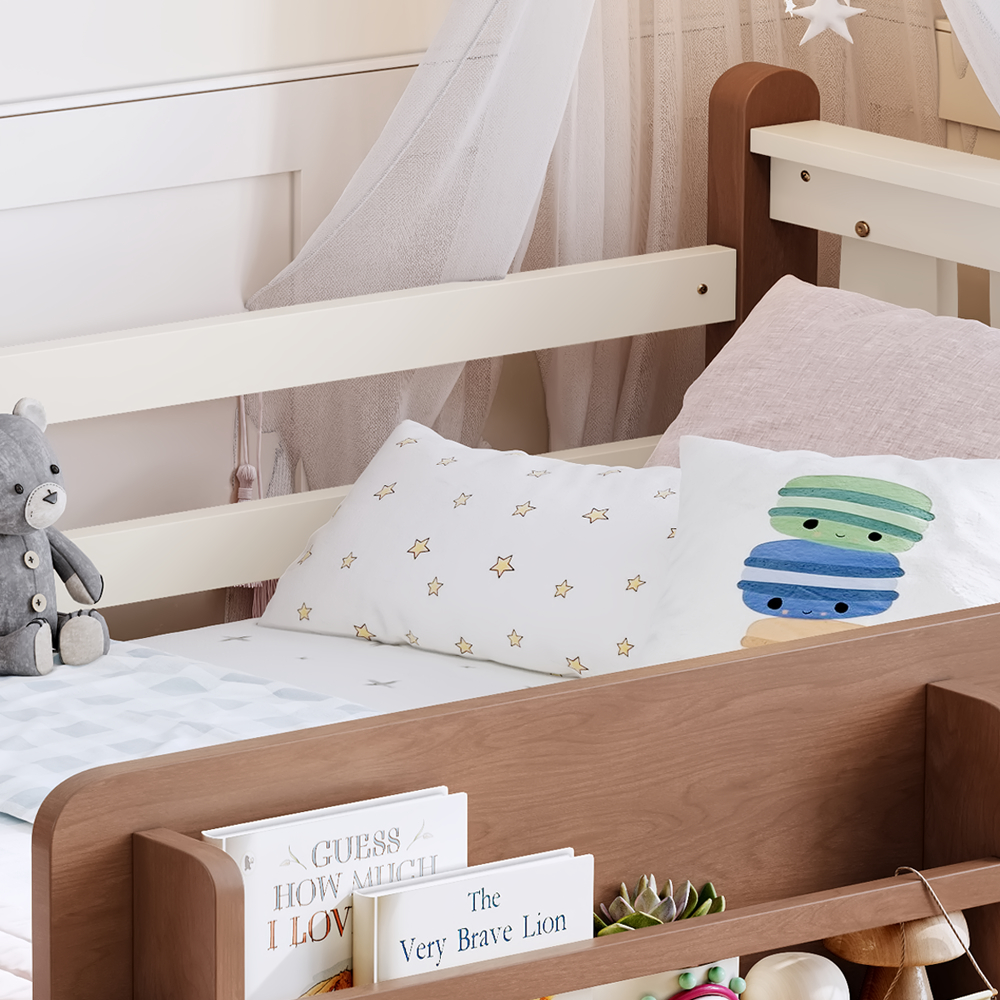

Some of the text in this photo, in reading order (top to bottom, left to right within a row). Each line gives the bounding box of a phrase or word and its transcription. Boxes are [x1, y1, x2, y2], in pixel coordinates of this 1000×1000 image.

[311, 827, 401, 868] GUESS
[273, 855, 438, 911] HOW MUCH
[467, 887, 501, 912] The
[267, 906, 352, 951] I LOV
[400, 912, 567, 966] Very Brave Lion
